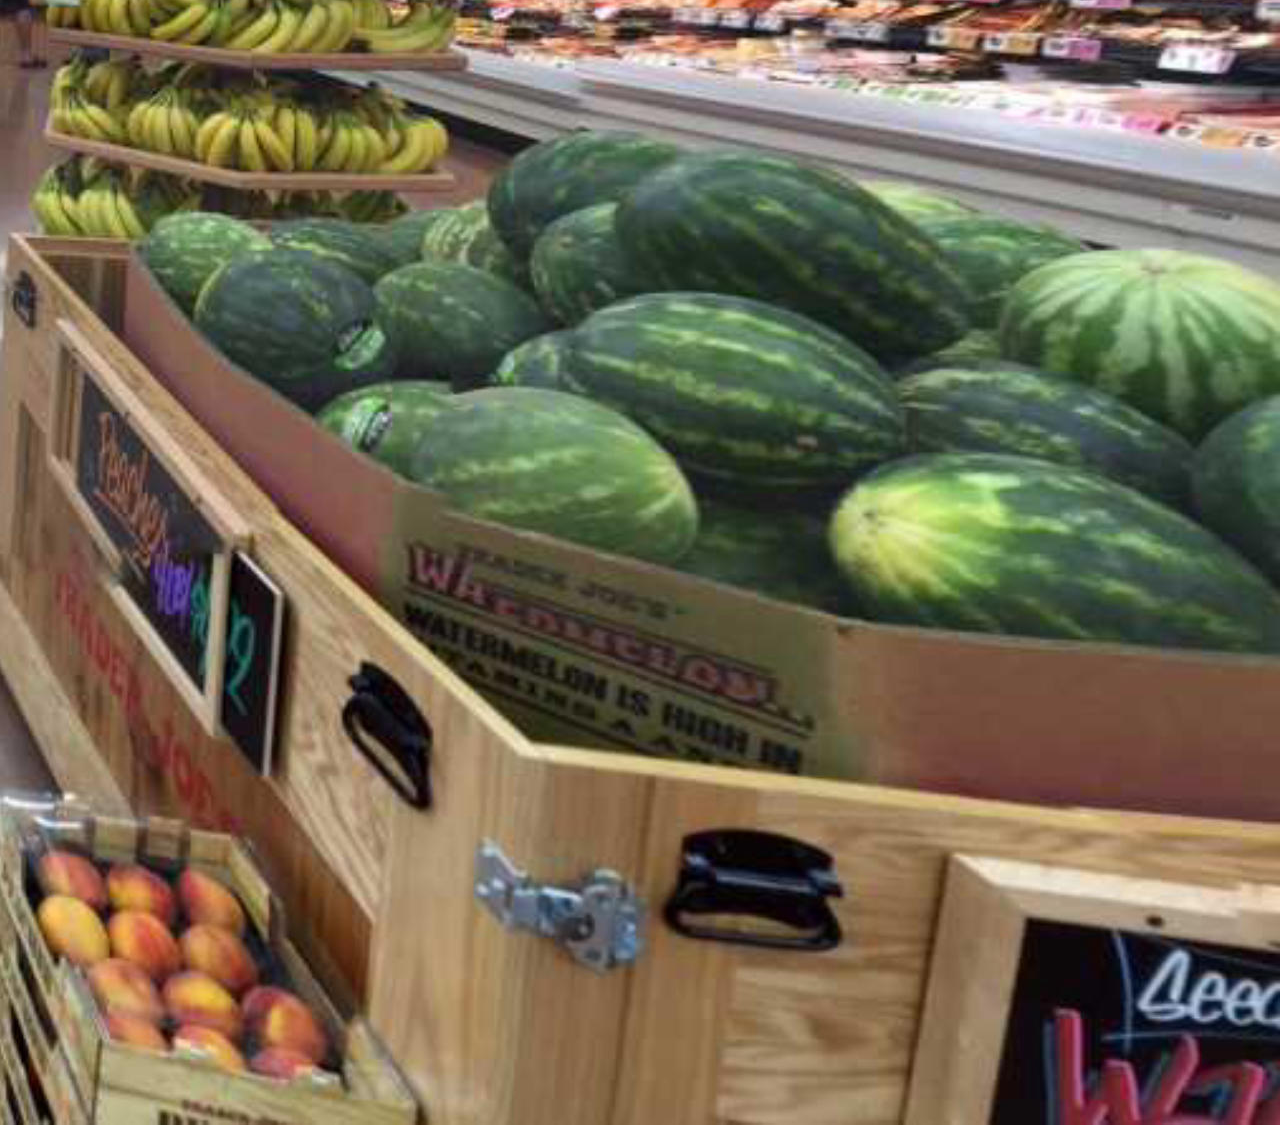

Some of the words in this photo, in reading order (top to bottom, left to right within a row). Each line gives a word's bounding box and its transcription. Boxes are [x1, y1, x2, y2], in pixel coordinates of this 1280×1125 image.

[403, 600, 608, 701] WATERMELON
[616, 682, 650, 716] IS
[662, 700, 749, 757] HIGH
